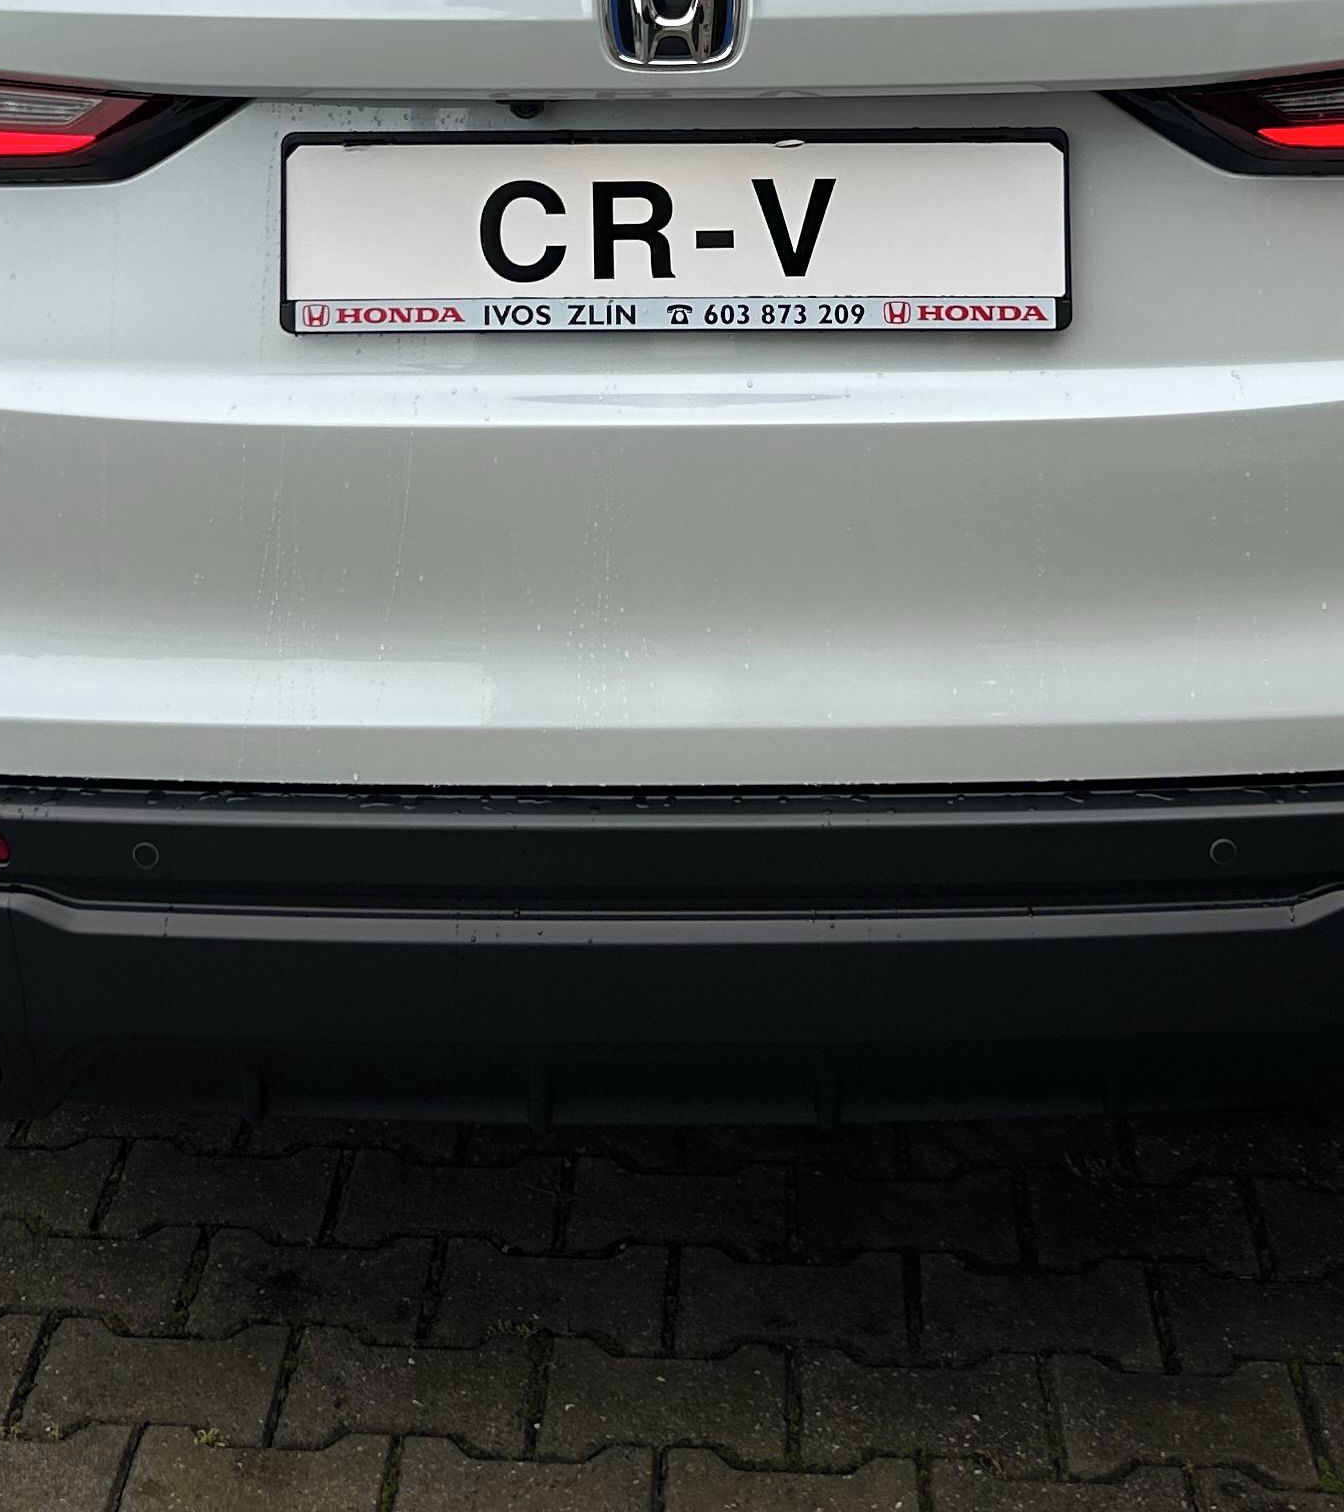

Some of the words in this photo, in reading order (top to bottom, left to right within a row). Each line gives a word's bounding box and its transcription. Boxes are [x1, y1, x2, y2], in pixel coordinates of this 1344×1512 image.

[478, 177, 838, 284] CR-V
[335, 306, 466, 324] HONDA
[484, 304, 552, 326] IVOS
[567, 299, 636, 326] ZLÍN
[703, 303, 751, 325] 603
[761, 303, 807, 325] 873
[817, 303, 866, 325] 209
[916, 304, 1049, 322] HONDA
